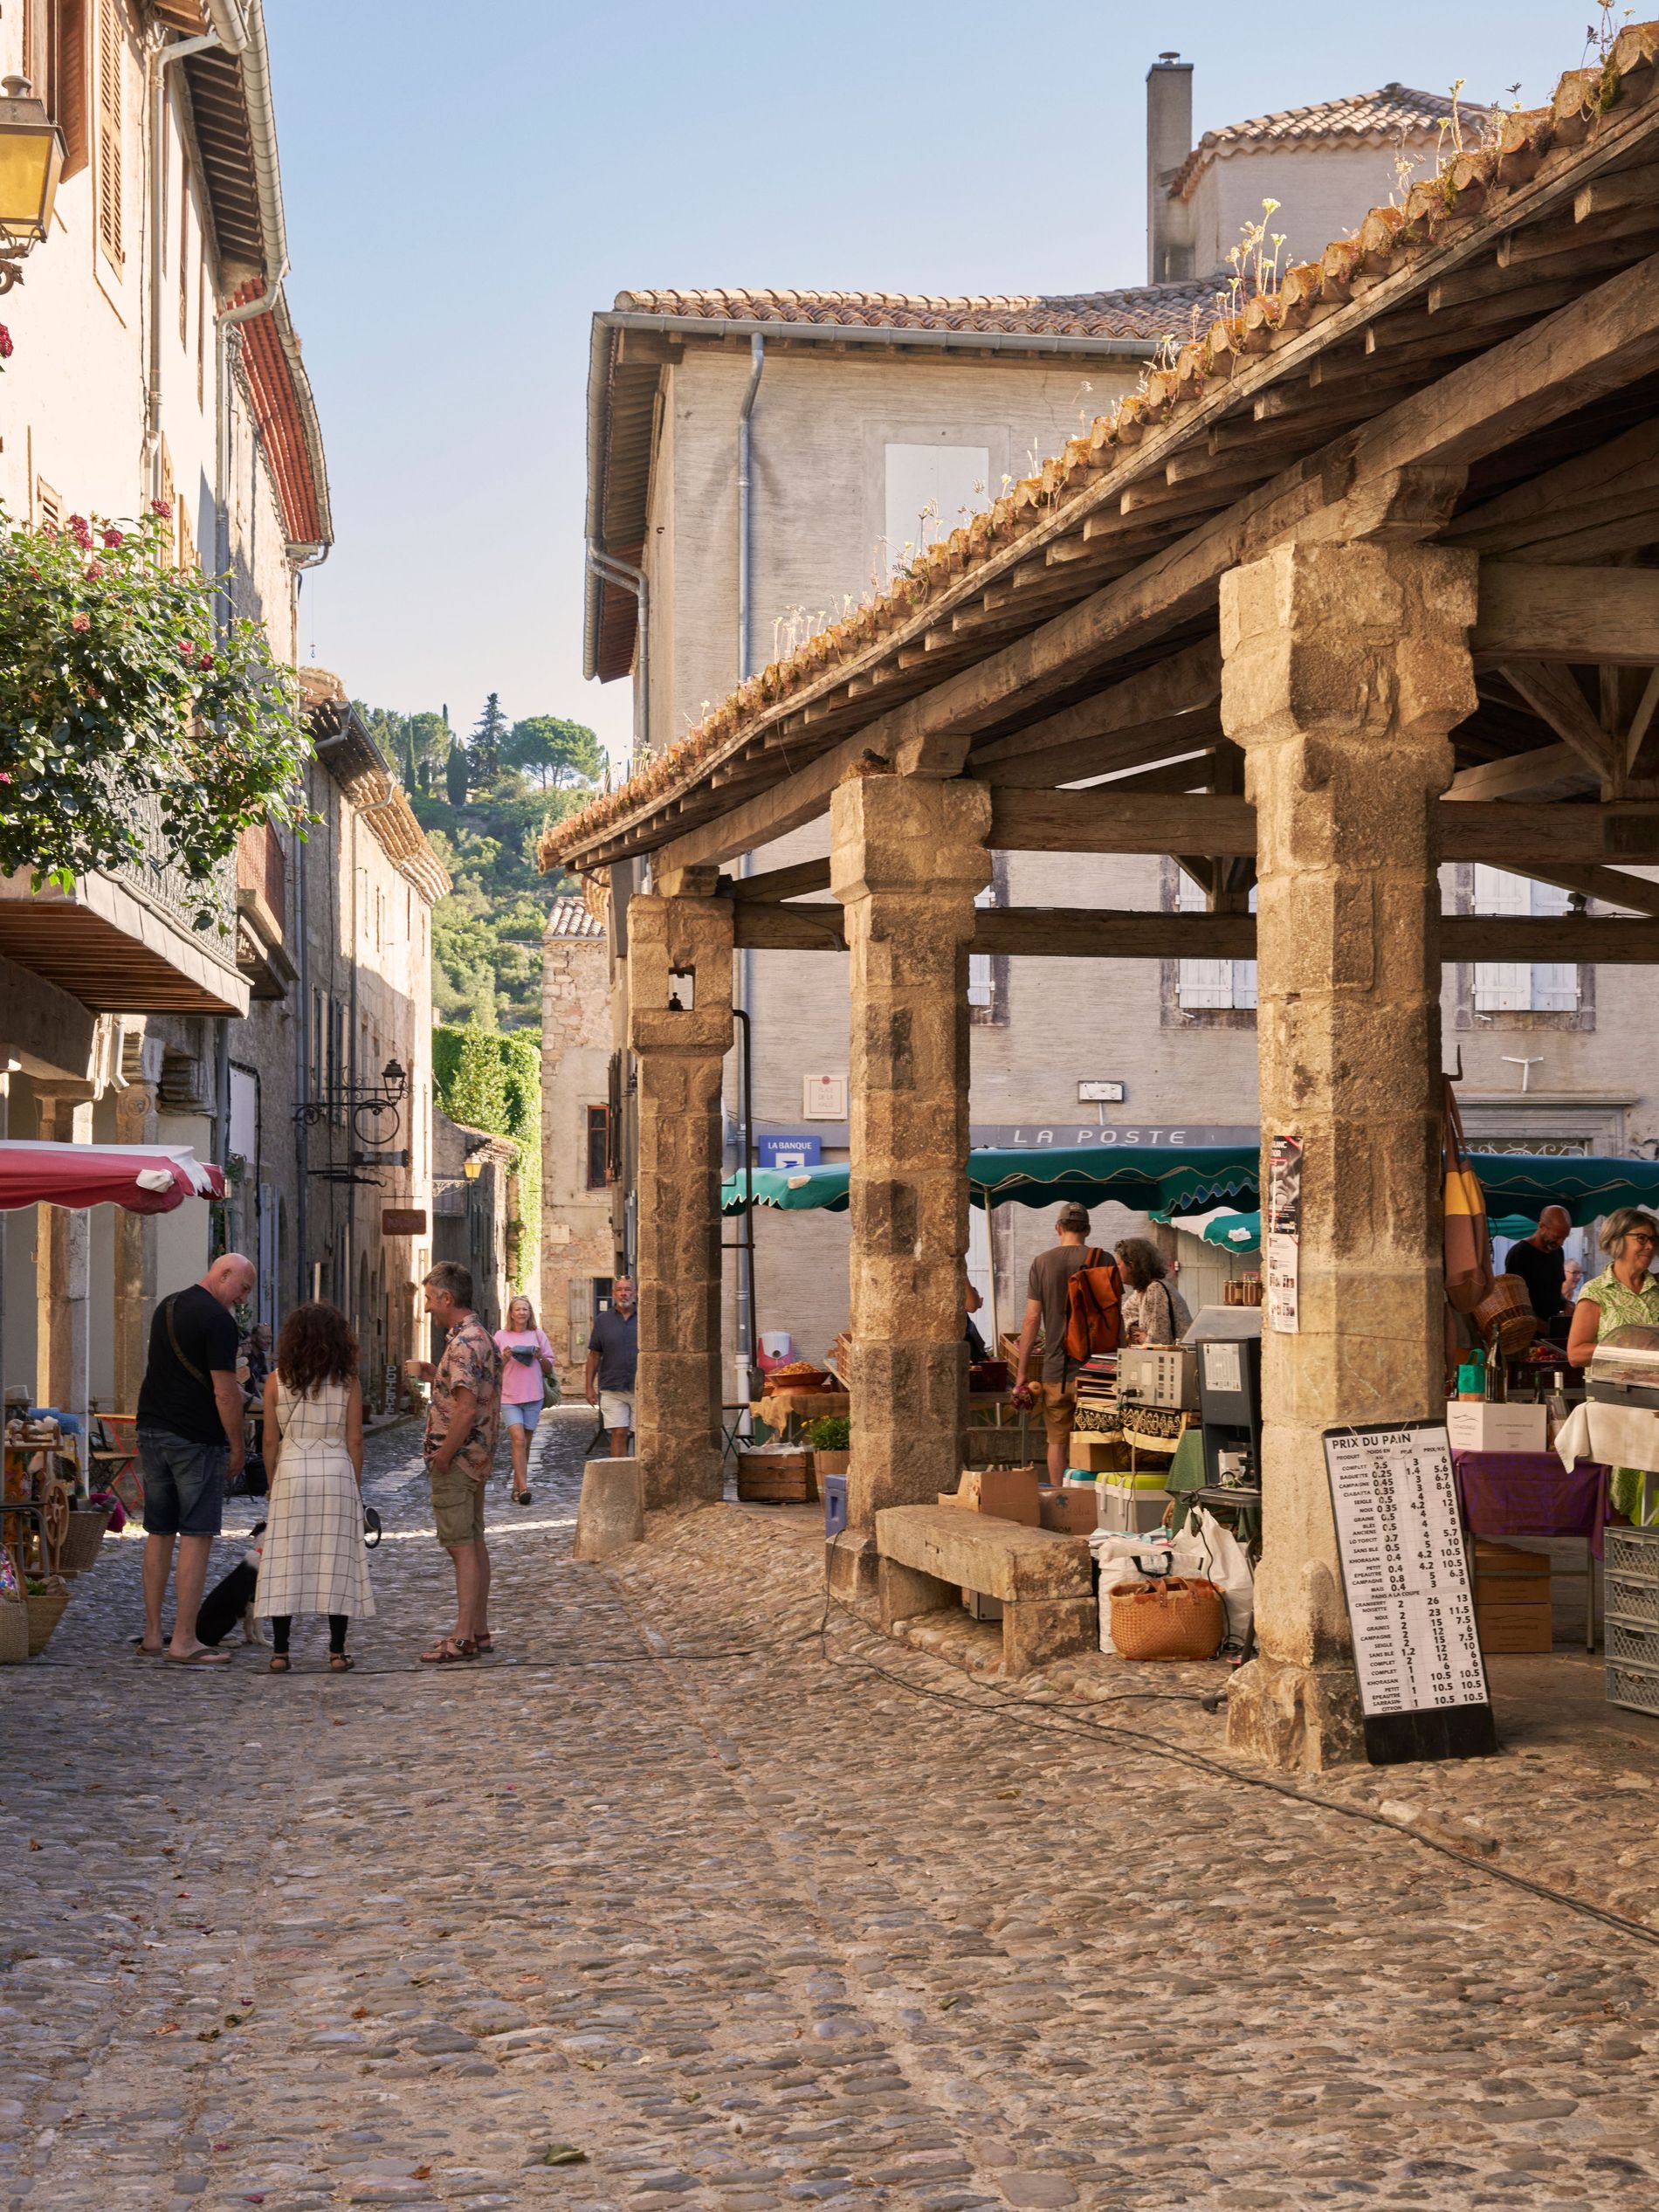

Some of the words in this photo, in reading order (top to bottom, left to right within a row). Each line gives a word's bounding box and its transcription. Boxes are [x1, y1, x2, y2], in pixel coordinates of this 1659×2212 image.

[1014, 1129, 1054, 1143] LA
[1077, 1130, 1187, 1144] POSTE
[1332, 1438, 1359, 1449] PRIX
[1362, 1437, 1378, 1446] DU
[1382, 1434, 1411, 1444] PAIN
[1372, 1470, 1392, 1478] 0.25
[1377, 1504, 1397, 1513] 035
[1443, 1528, 1457, 1537] 5.7
[1441, 1547, 1461, 1556] 10.5
[1420, 1561, 1434, 1570] 4.2
[1390, 1575, 1405, 1583] 0.8
[1449, 1606, 1470, 1615] 11.5
[1456, 1616, 1470, 1624] 7.5
[1431, 1671, 1451, 1680] 10.5
[1460, 1669, 1479, 1678] 10.5
[1433, 1683, 1453, 1692] 10.5
[1462, 1680, 1481, 1689] 10.5
[1435, 1696, 1455, 1705] 10.5
[1463, 1692, 1483, 1701] 10.5
